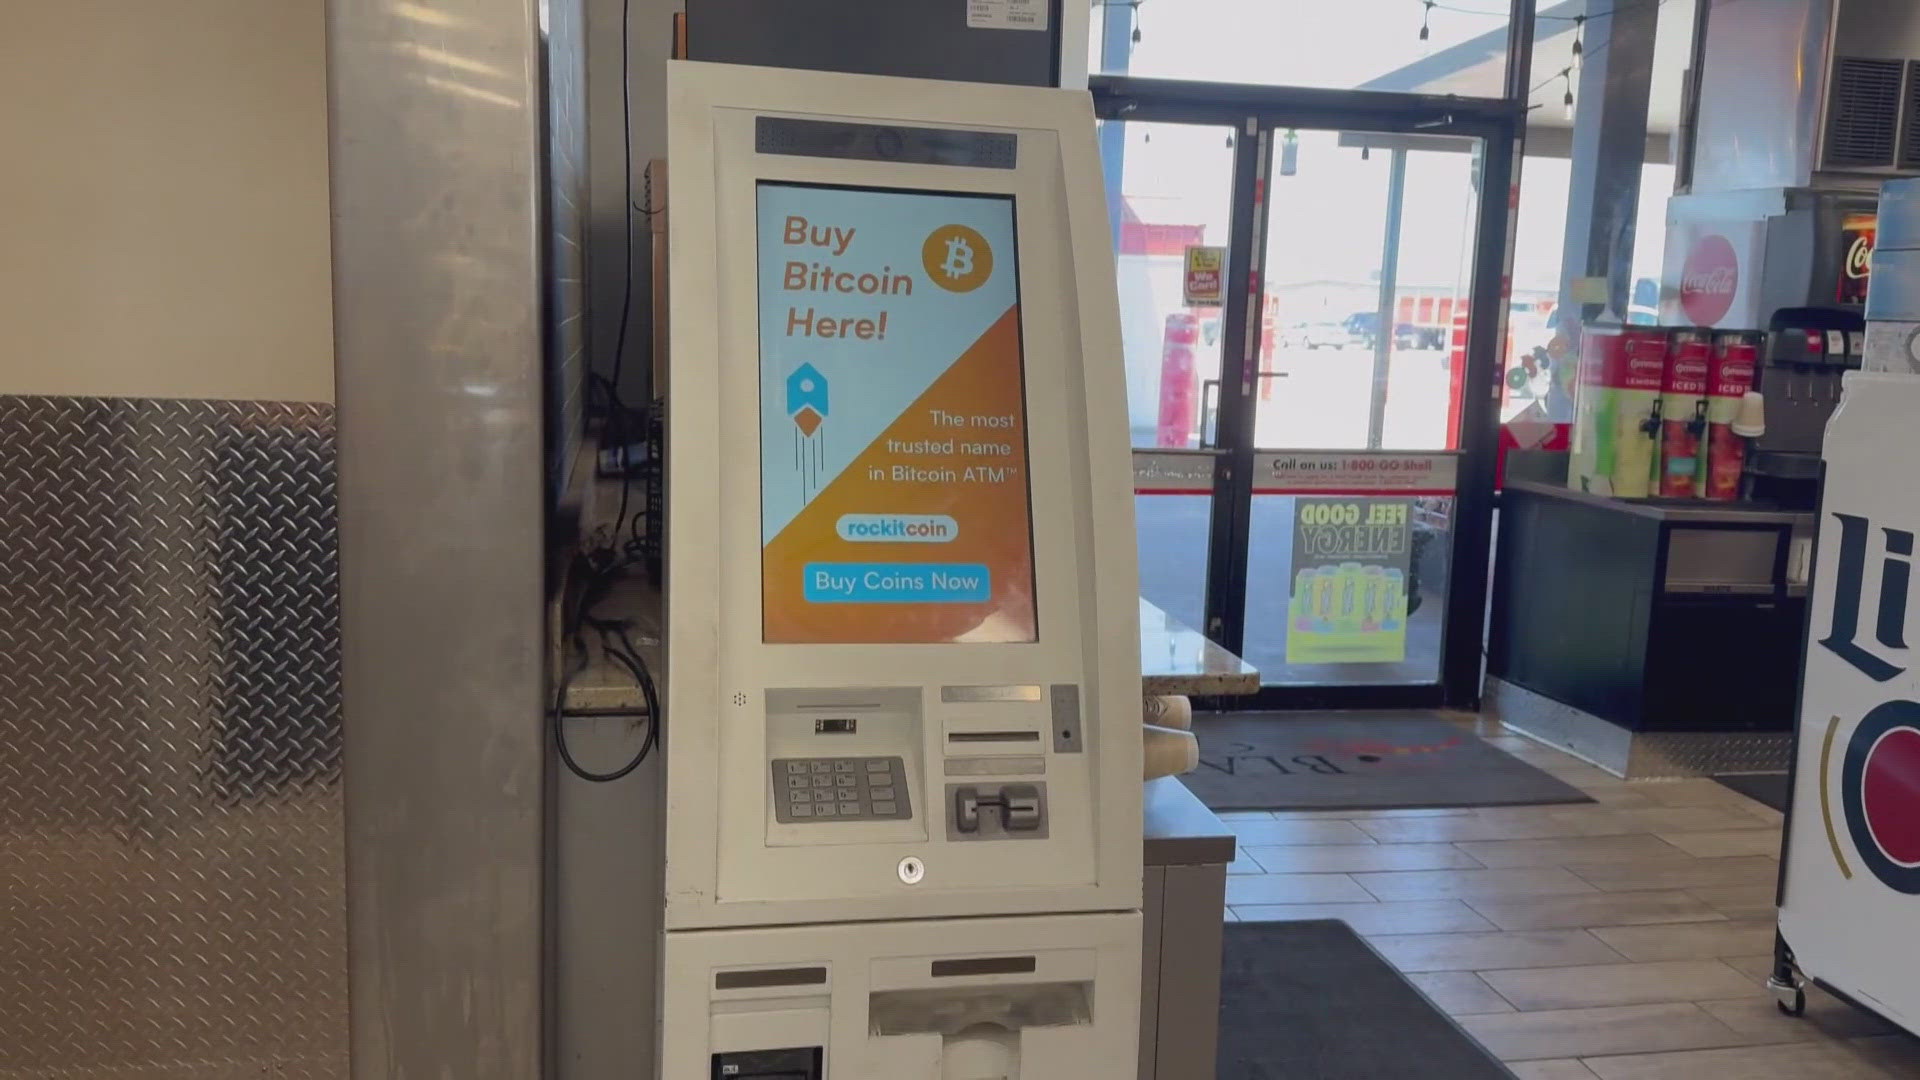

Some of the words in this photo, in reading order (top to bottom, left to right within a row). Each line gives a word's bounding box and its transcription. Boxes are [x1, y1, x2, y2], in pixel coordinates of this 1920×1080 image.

[783, 215, 856, 257] Buy
[783, 261, 914, 296] Bitcoin
[785, 307, 888, 341] Here!
[1672, 381, 1697, 391] ICED
[1718, 384, 1743, 393] ICED
[929, 410, 965, 428] The
[970, 413, 1016, 429] most
[887, 438, 953, 456] trusted
[959, 441, 1011, 456] name
[868, 466, 885, 482] in
[891, 466, 957, 483] Bitcoin
[1273, 459, 1296, 471] Call
[1300, 461, 1315, 471] on
[1320, 461, 1337, 471] us:
[1403, 460, 1433, 472] Shell
[848, 518, 948, 538] rockitcoin
[815, 571, 856, 595] Buy
[863, 571, 924, 592] Coins
[931, 571, 980, 592] Now
[1178, 755, 1350, 777] BLA
